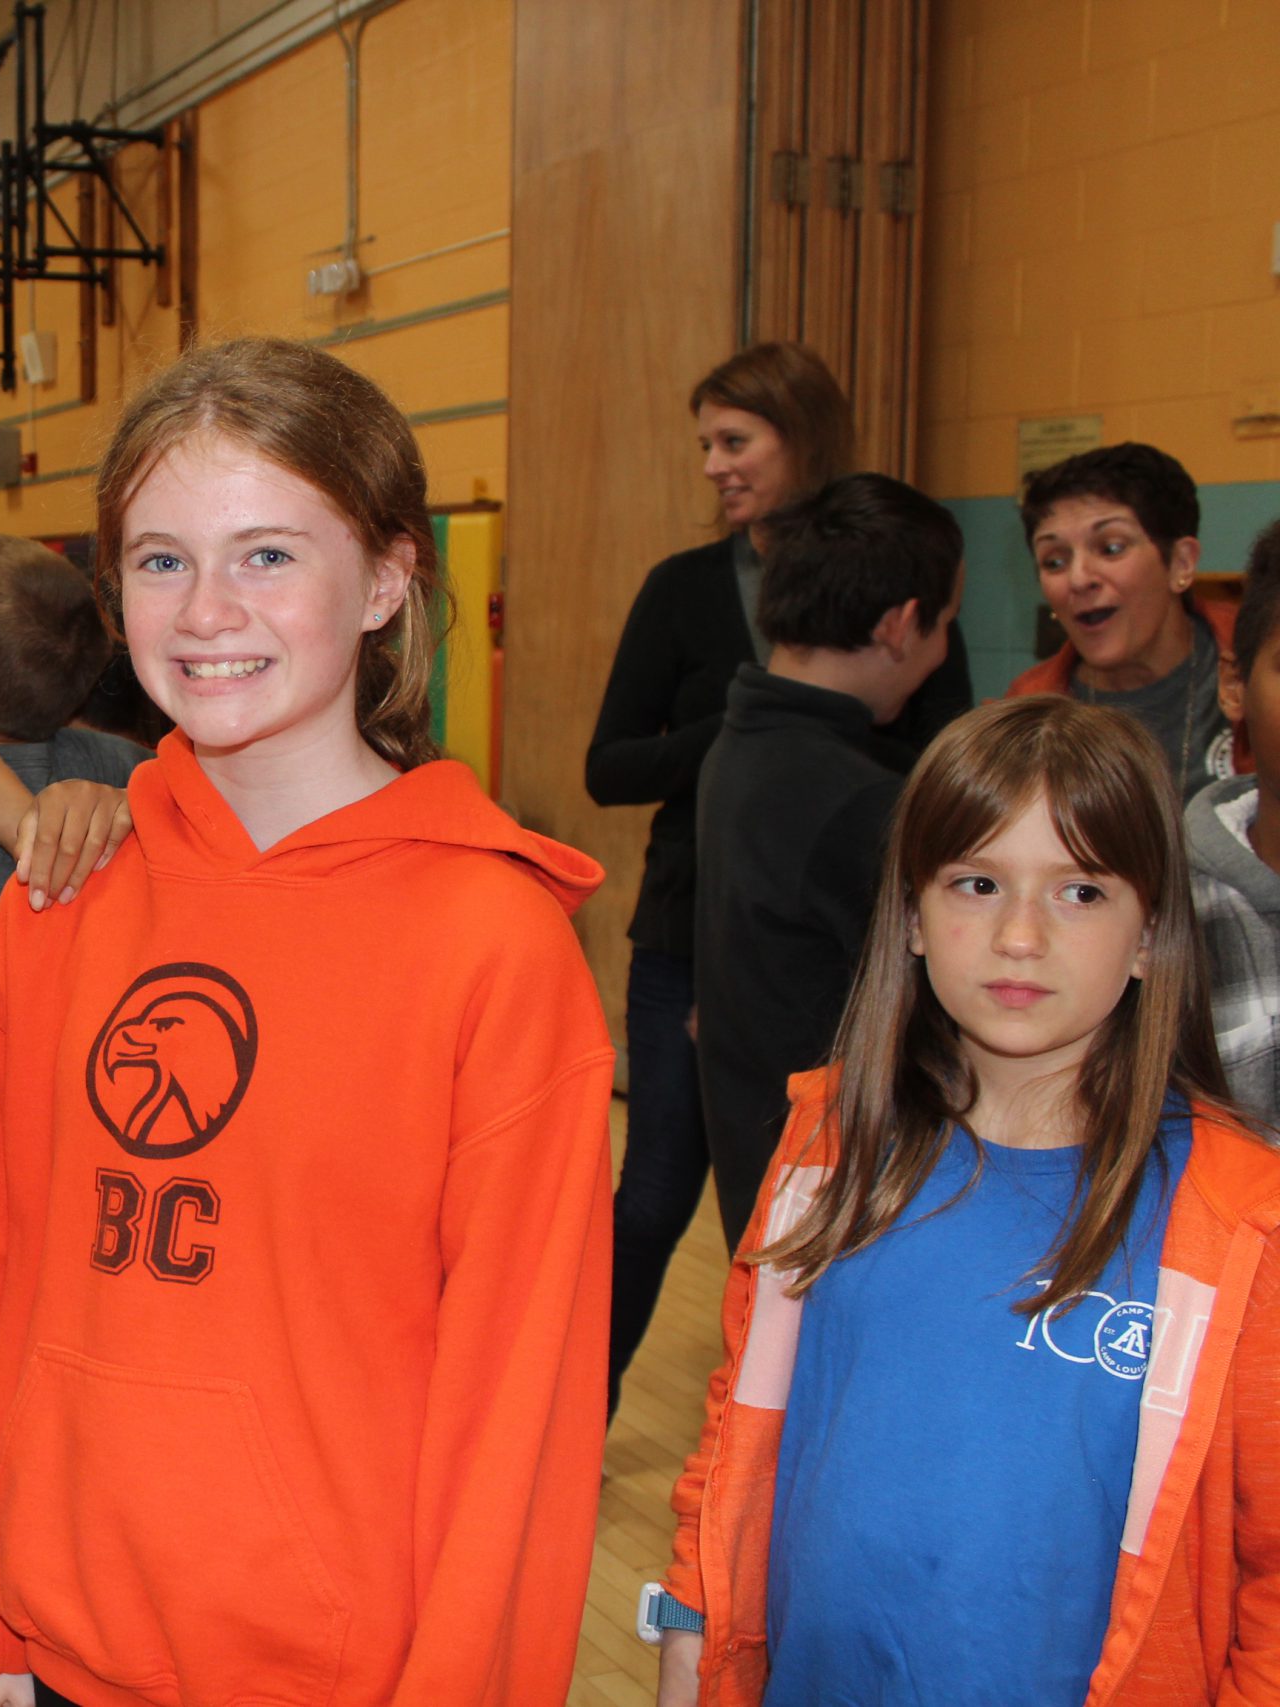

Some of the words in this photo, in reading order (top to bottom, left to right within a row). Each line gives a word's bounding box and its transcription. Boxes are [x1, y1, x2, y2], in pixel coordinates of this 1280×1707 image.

[89, 1167, 221, 1286] BC
[1116, 1307, 1144, 1318] CAMP
[1100, 1346, 1117, 1366] CAMP
